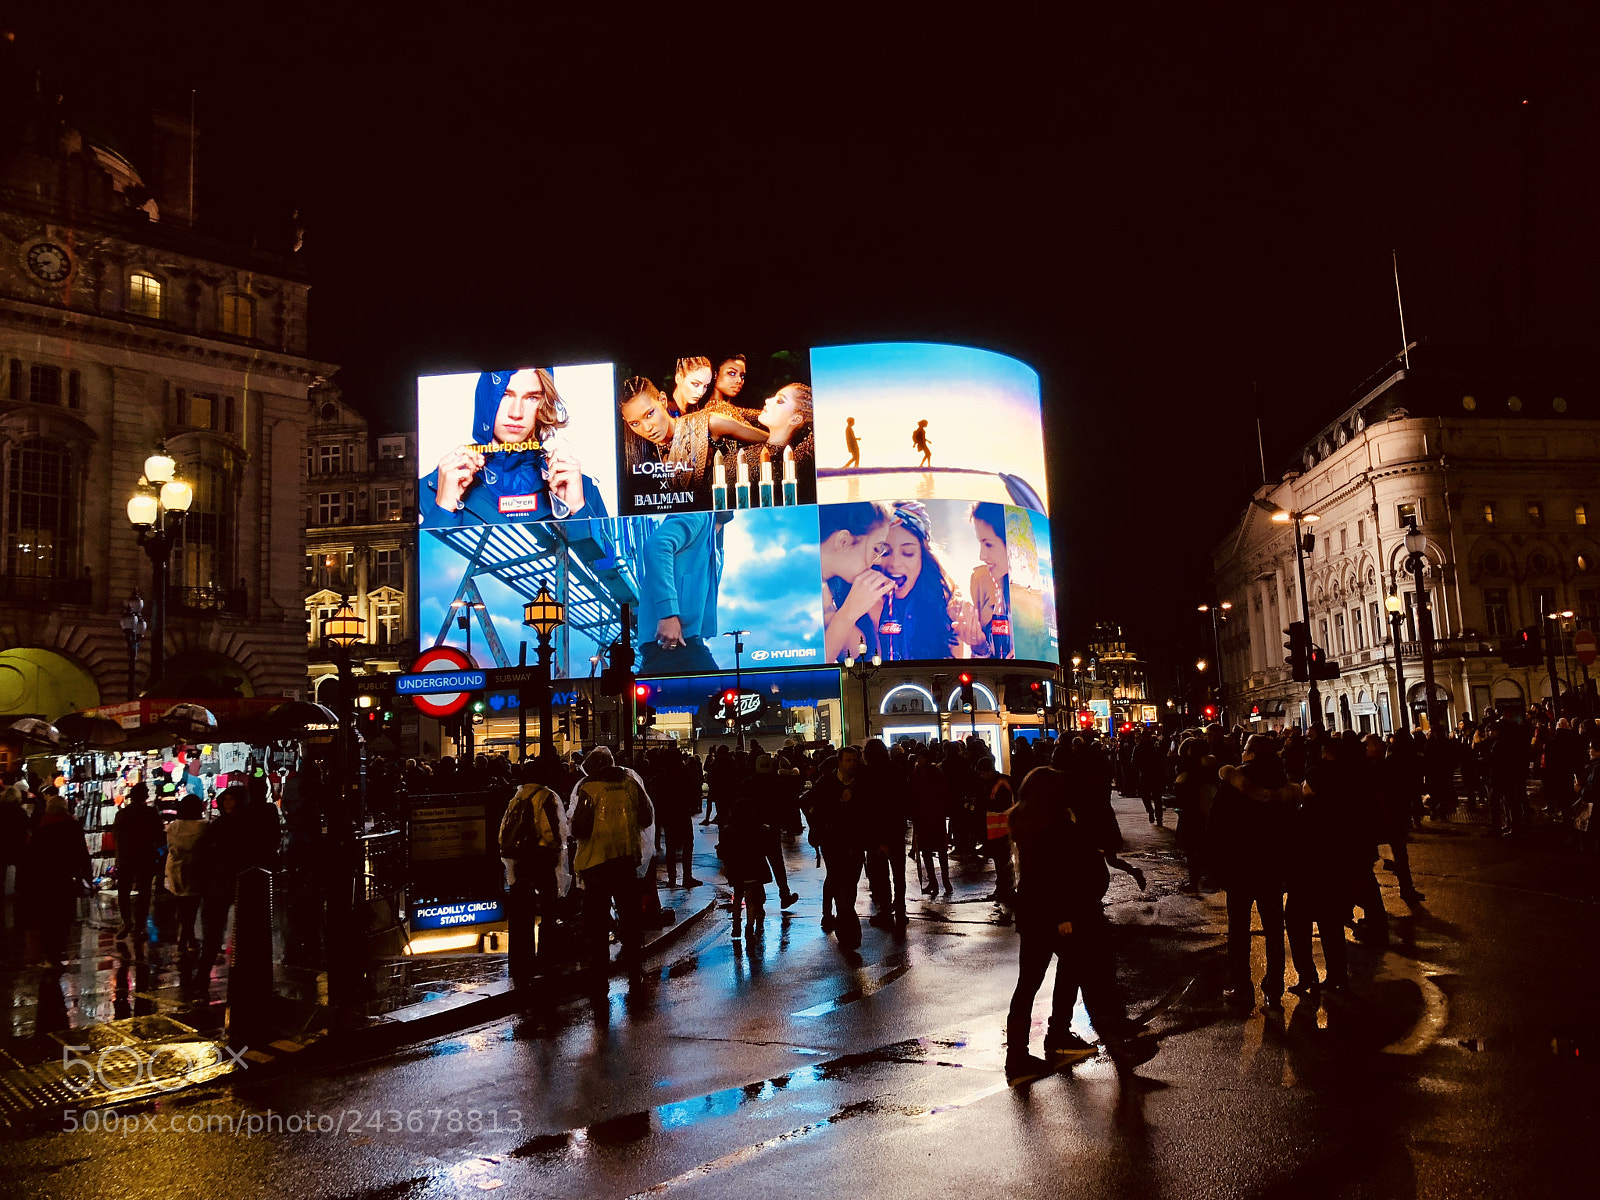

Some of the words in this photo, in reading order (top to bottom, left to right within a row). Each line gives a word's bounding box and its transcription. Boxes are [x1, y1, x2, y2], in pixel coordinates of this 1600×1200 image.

[632, 461, 694, 475] L'ORÉAL
[634, 491, 694, 507] BALMAIN
[770, 648, 817, 659] HYUNDAI
[398, 675, 483, 690] UNDERGROUND
[495, 673, 532, 683] SUBWAY
[358, 682, 388, 691] PUBLIC
[417, 904, 466, 918] PICCADILLY
[467, 901, 498, 912] CIRCUS
[440, 913, 476, 925] STATION
